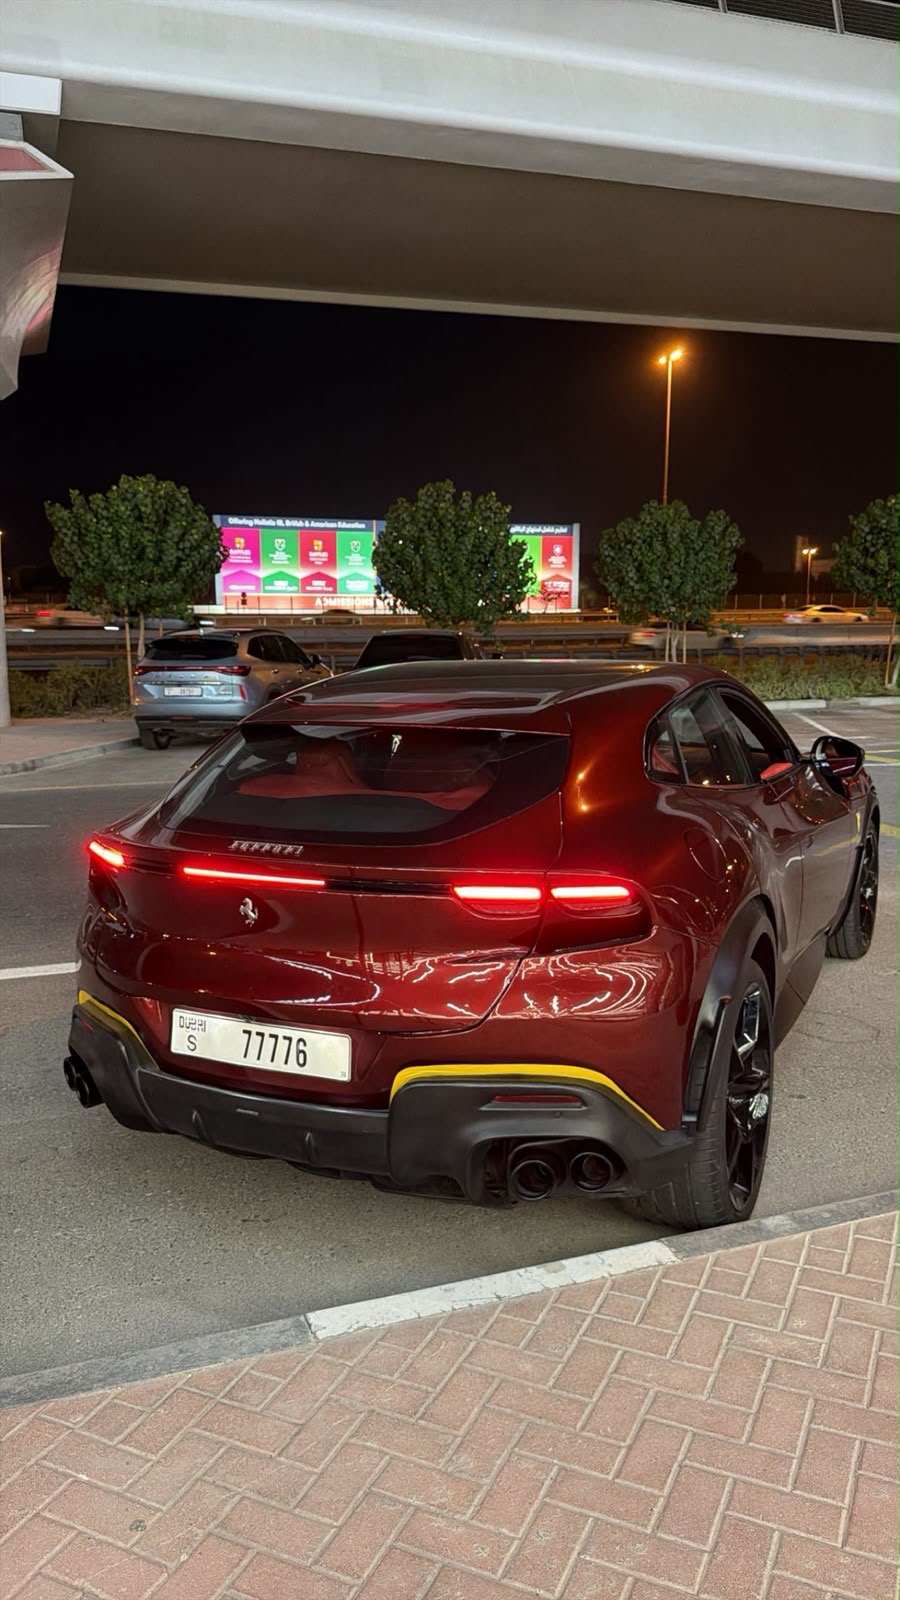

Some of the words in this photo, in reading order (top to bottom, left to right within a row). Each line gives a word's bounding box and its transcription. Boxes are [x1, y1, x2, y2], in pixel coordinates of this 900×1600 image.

[228, 517, 253, 527] Offering
[310, 520, 337, 528] American
[337, 521, 366, 529] Education
[186, 1034, 198, 1052] S
[242, 1029, 308, 1068] 77776
